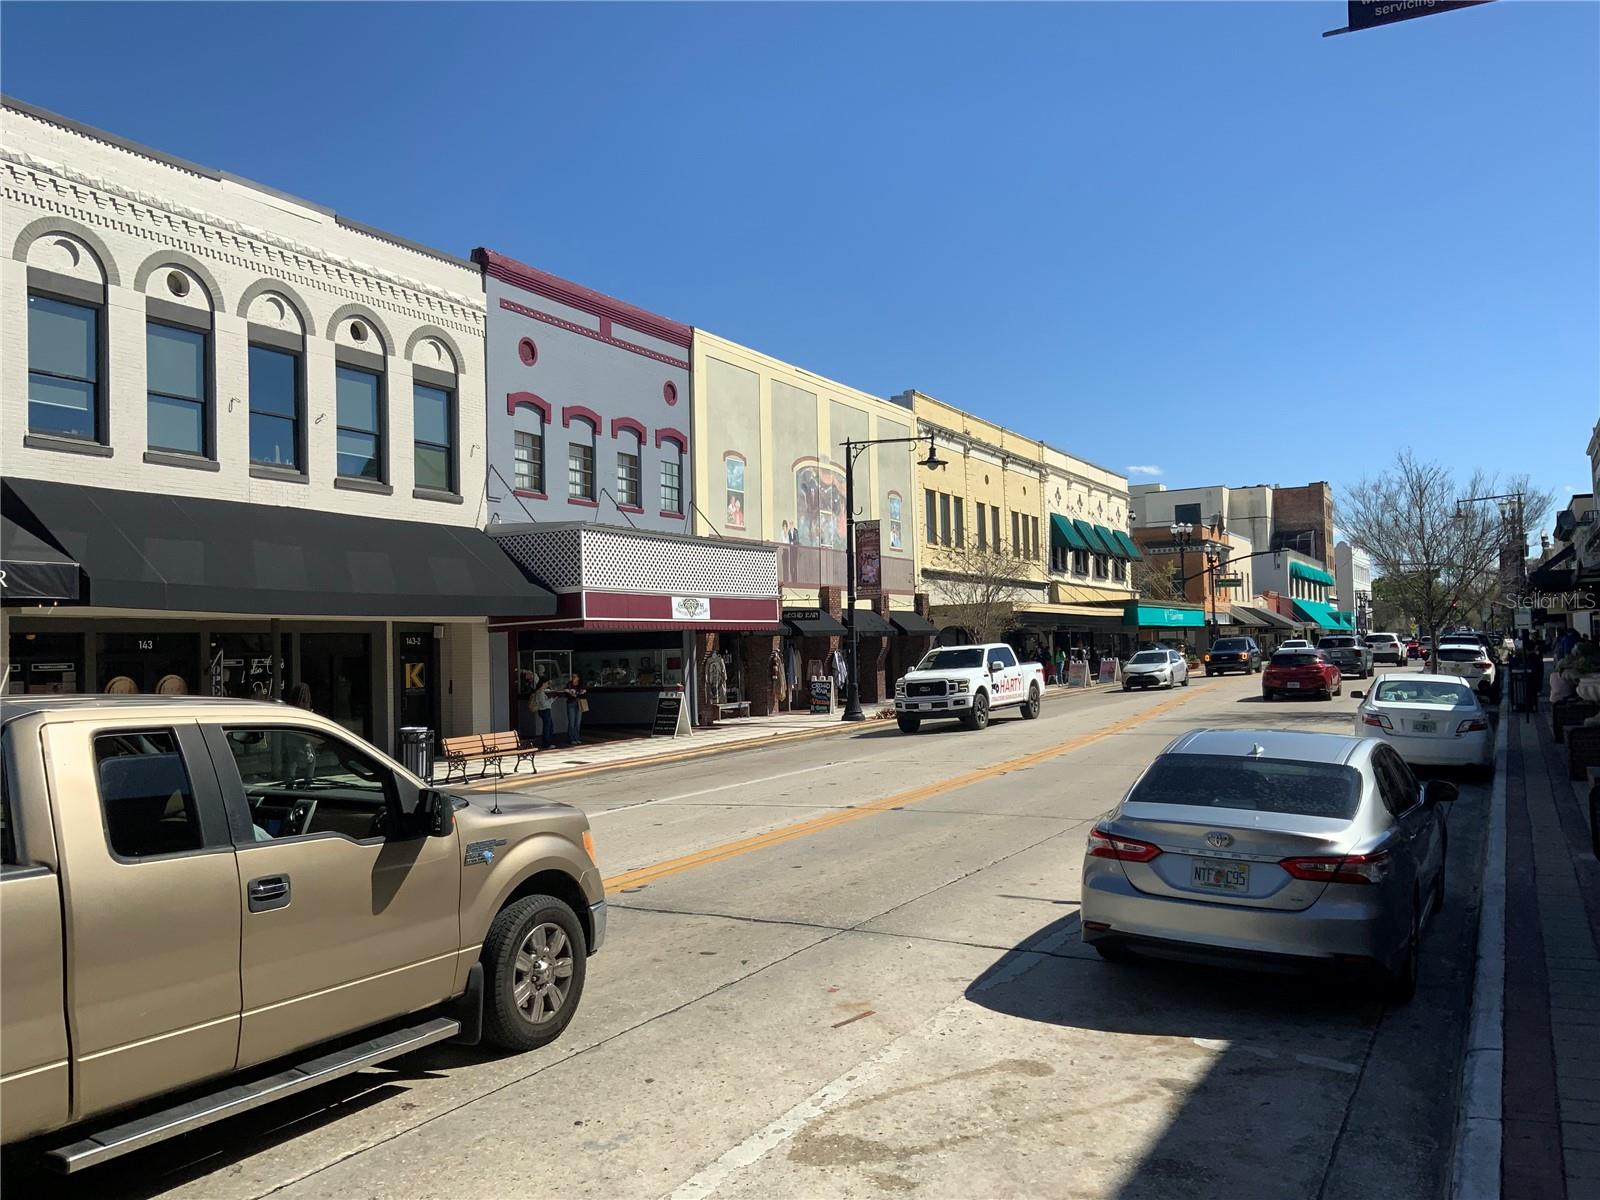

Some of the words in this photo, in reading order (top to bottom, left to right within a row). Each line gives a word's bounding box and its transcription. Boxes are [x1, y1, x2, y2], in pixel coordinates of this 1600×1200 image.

[1374, 0, 1436, 16] servicing
[138, 640, 153, 650] 143
[405, 637, 421, 645] 143-2
[212, 665, 221, 697] OPE
[405, 662, 425, 689] K
[999, 677, 1022, 694] HARTY
[1194, 866, 1213, 881] NTF
[1226, 870, 1246, 886] C95
